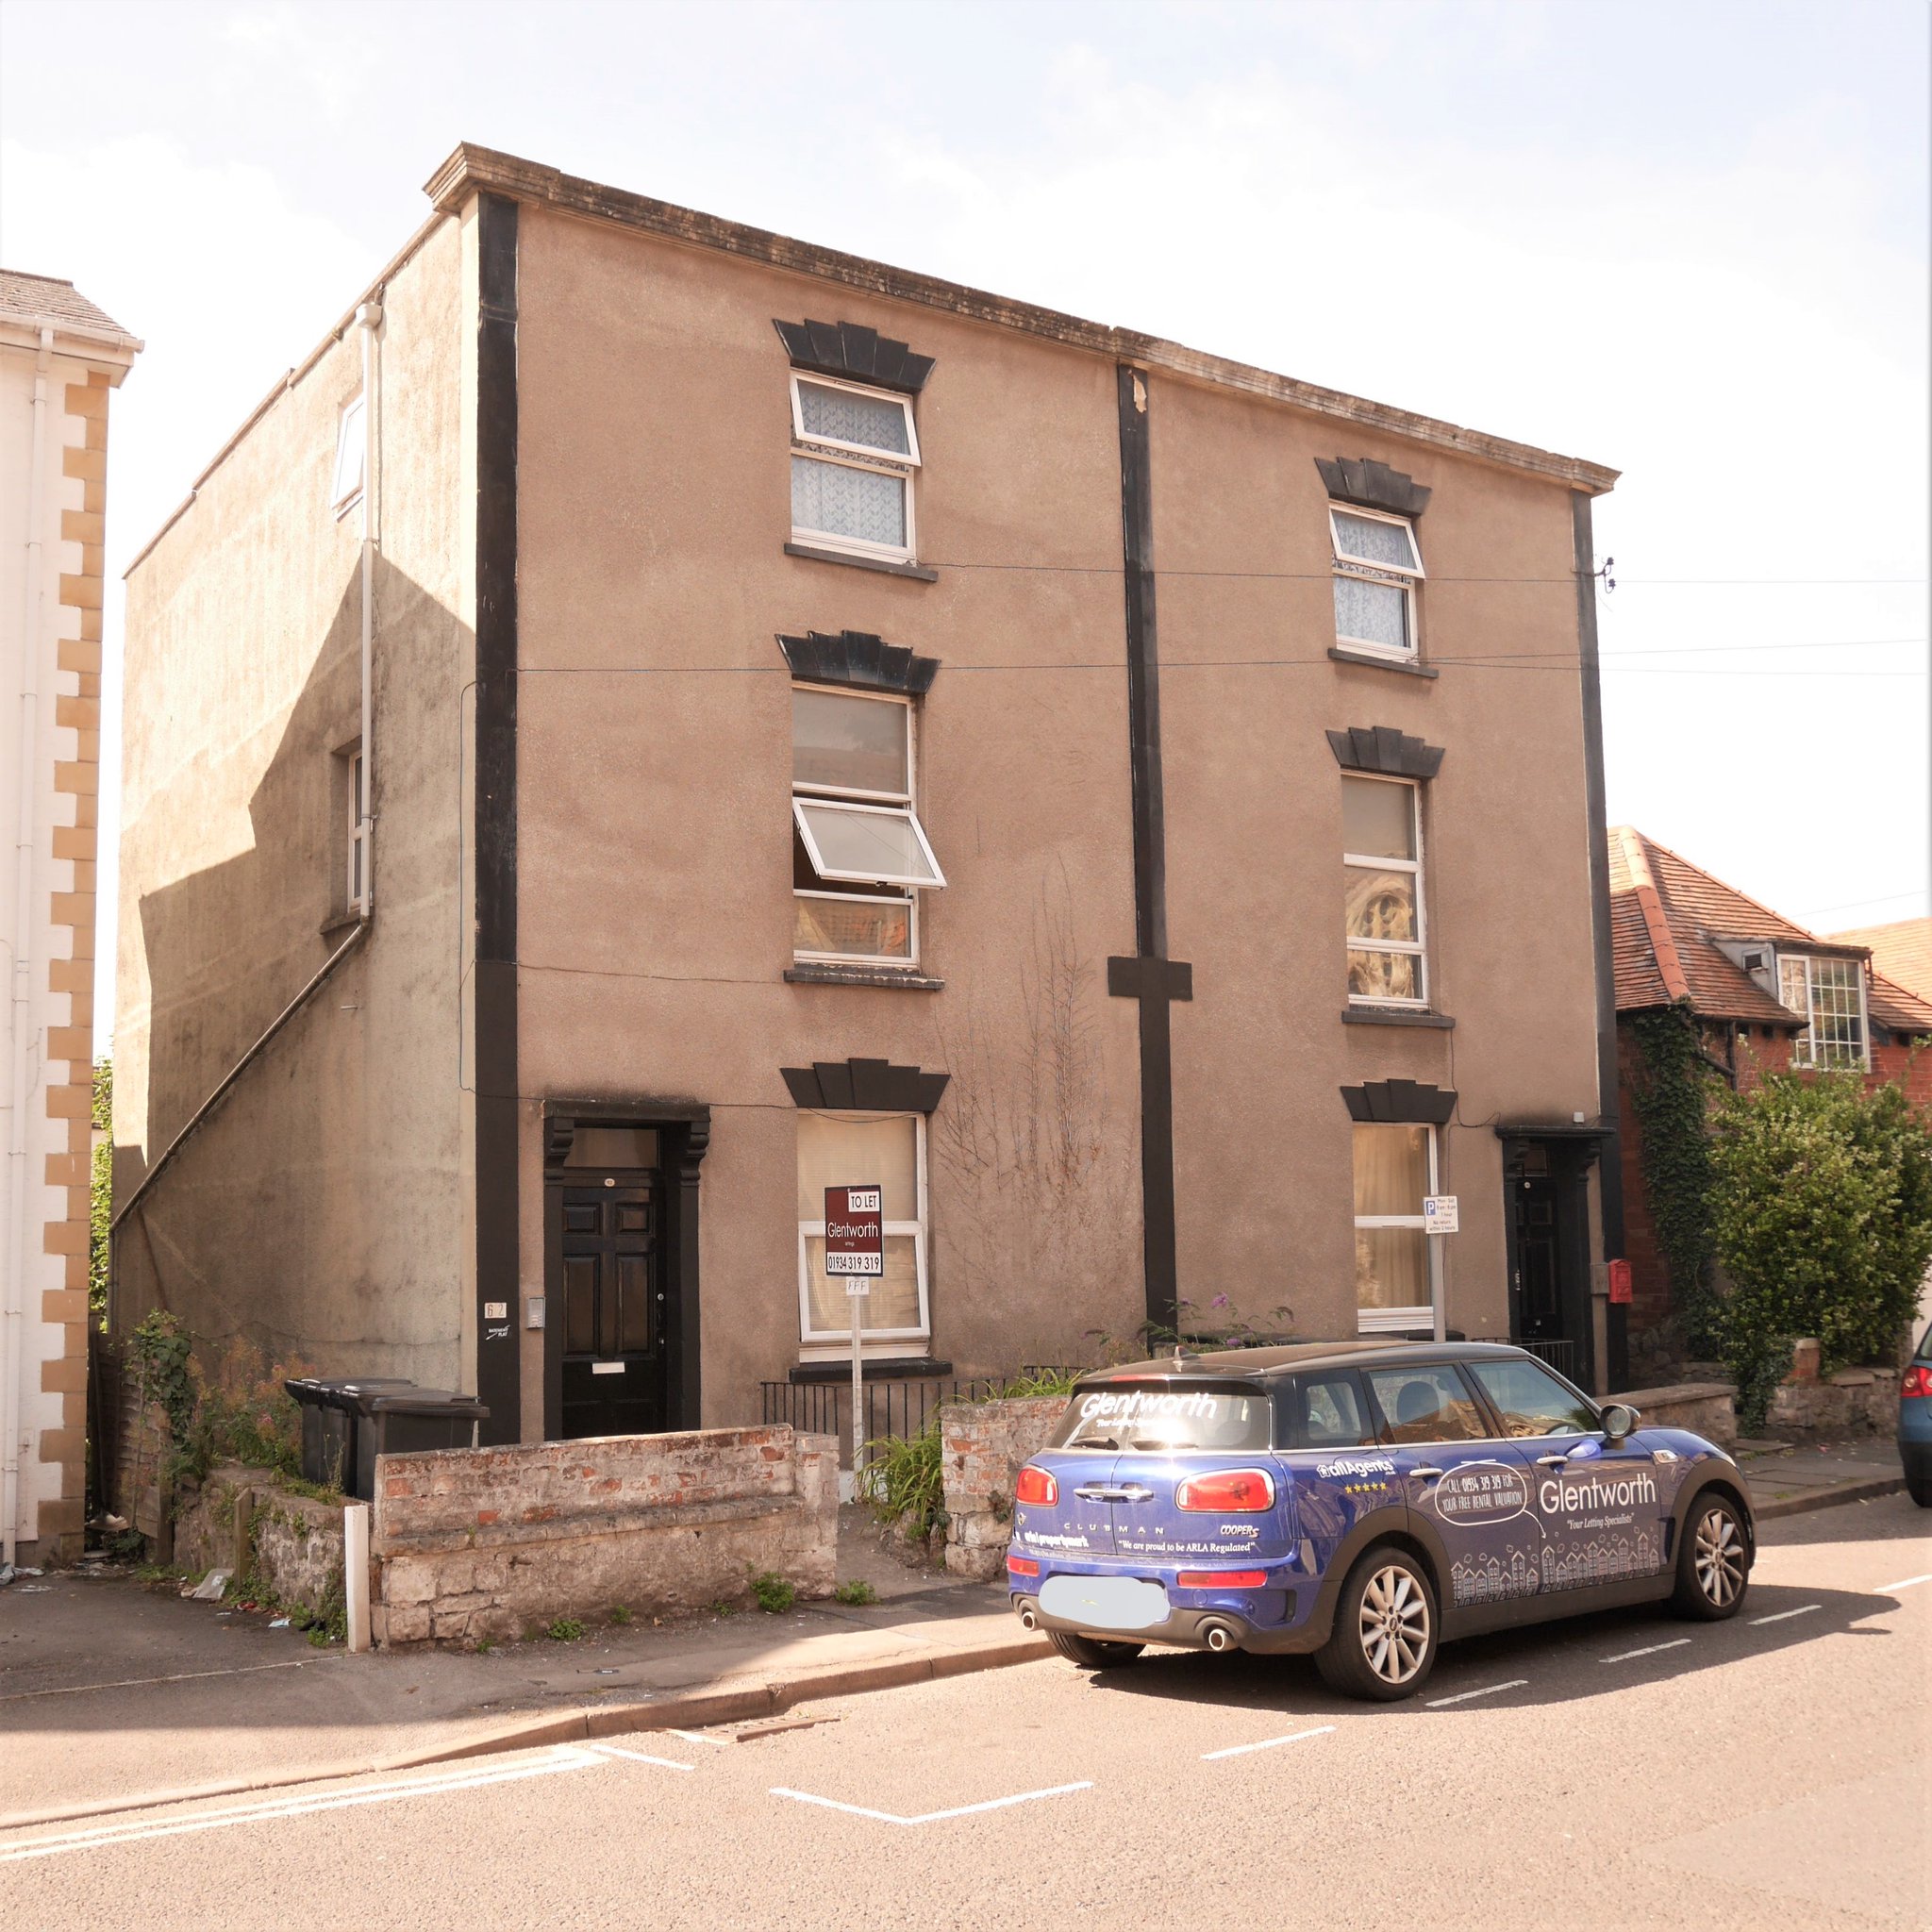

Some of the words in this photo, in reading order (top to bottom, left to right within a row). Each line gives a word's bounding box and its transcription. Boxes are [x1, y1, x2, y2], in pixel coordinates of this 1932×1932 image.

[851, 1196, 861, 1208] TO
[864, 1195, 877, 1208] LET
[1427, 1202, 1435, 1215] P
[827, 1222, 878, 1238] Glentworth
[828, 1256, 847, 1270] 01934
[848, 1257, 862, 1270] 319
[864, 1257, 880, 1271] 319
[1080, 1390, 1217, 1419] Glentworth
[1329, 1459, 1393, 1477] allAgents
[1447, 1479, 1461, 1493] CALL
[1462, 1477, 1479, 1492] 01934
[1480, 1476, 1490, 1491] 319
[1491, 1475, 1501, 1490] 319
[1502, 1474, 1513, 1488] FOR
[1540, 1473, 1657, 1513] Glentworth
[1442, 1497, 1457, 1512] YOUR
[1458, 1495, 1471, 1510] FREE
[1473, 1493, 1492, 1509] RENTAL
[1494, 1491, 1523, 1507] VALUATION
[1064, 1523, 1164, 1535] CLUBMAN
[1584, 1517, 1604, 1529] Letting
[1145, 1542, 1166, 1552] proud
[1167, 1543, 1174, 1552] to
[1175, 1542, 1185, 1552] be
[1186, 1543, 1208, 1552] ARLA
